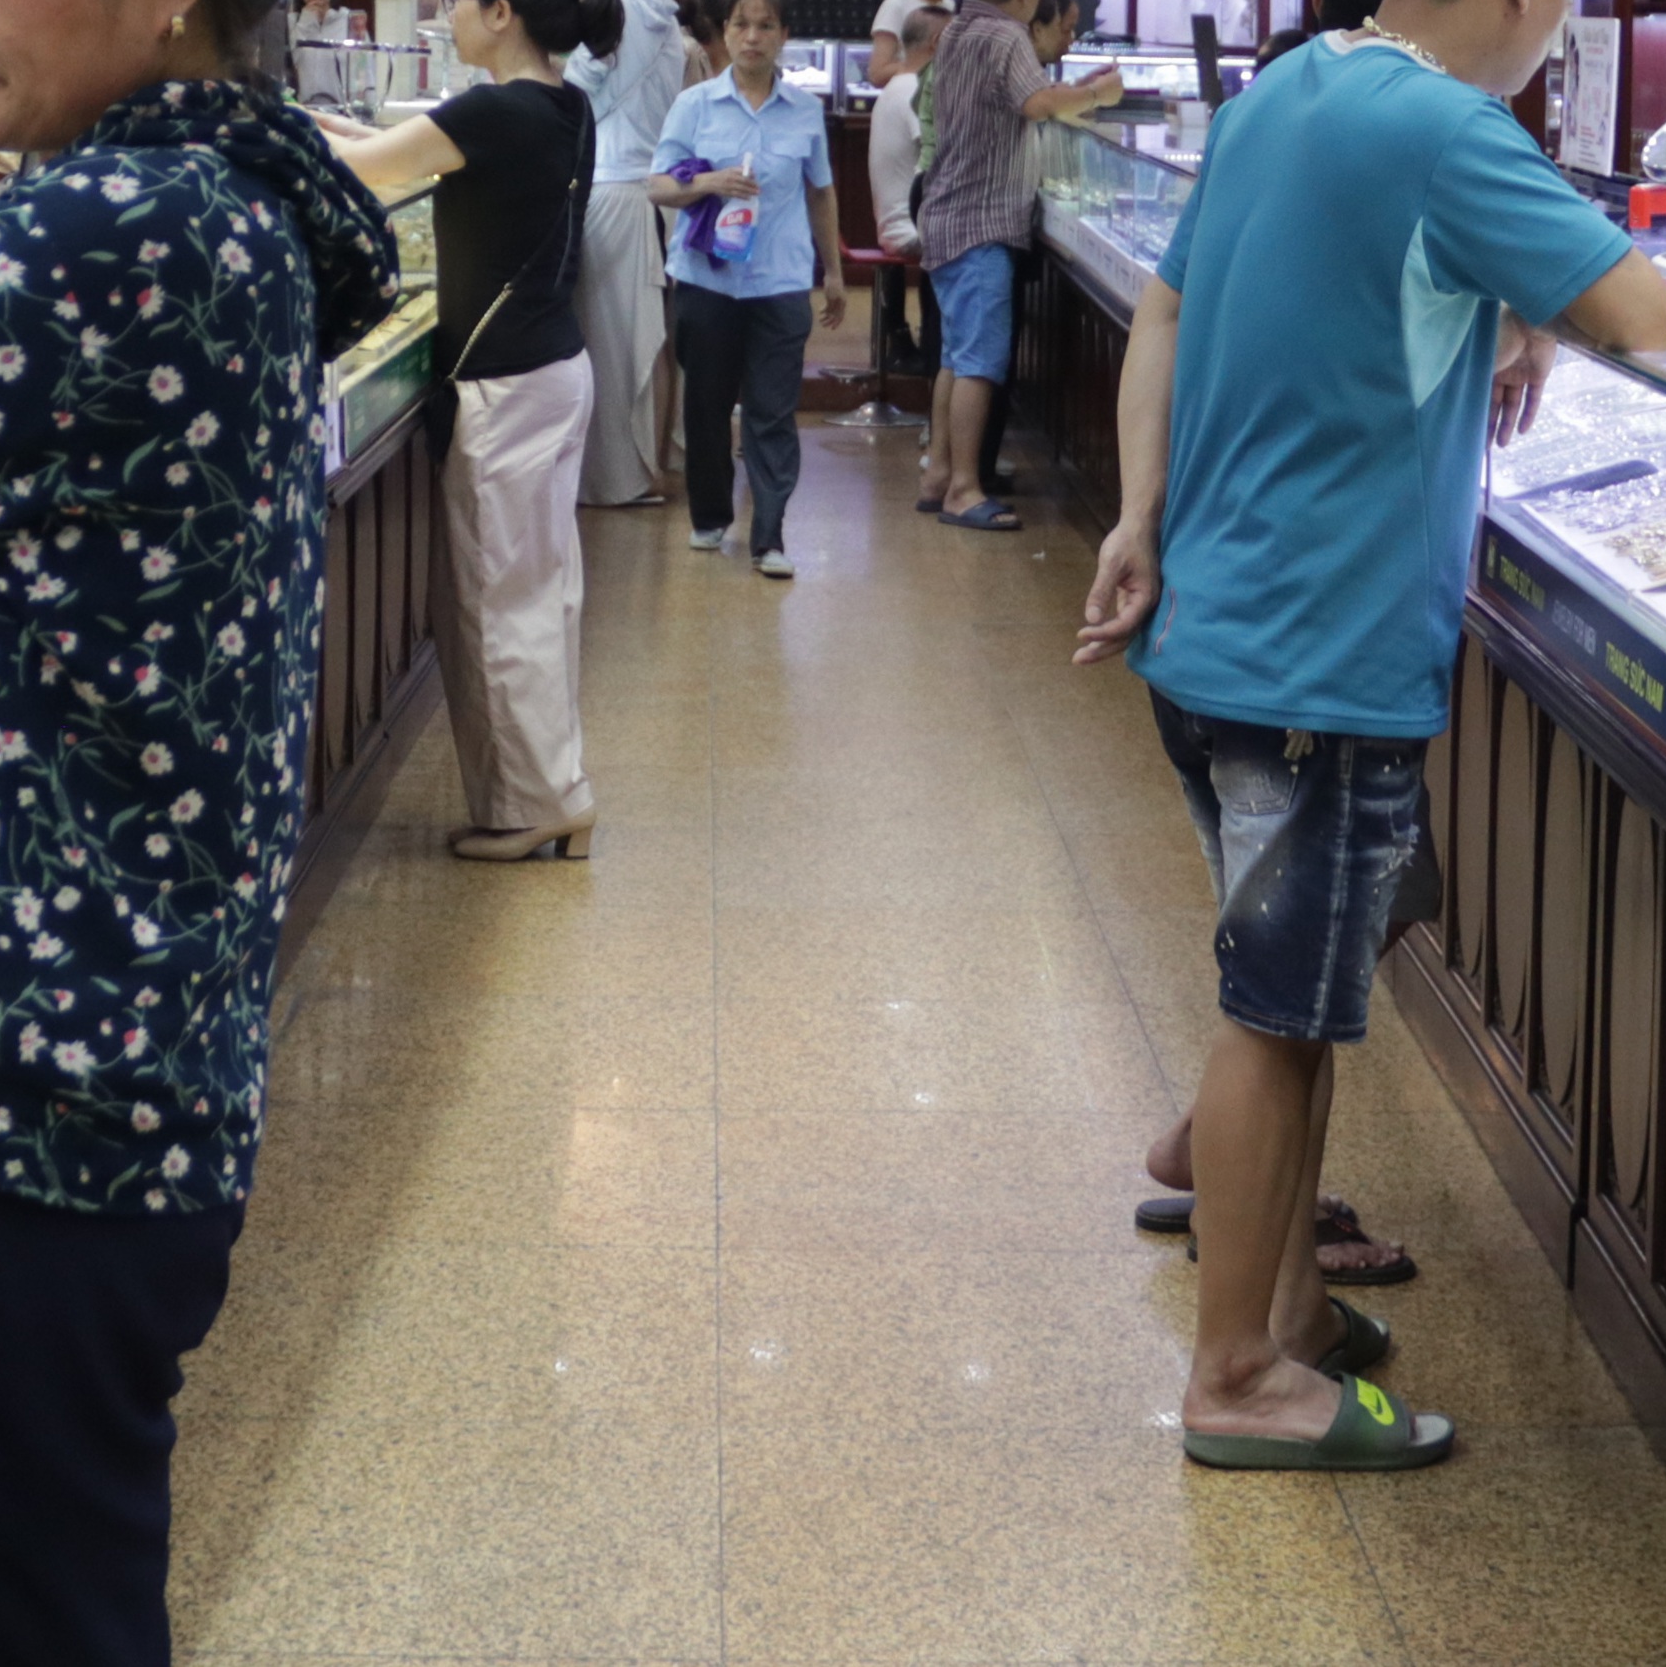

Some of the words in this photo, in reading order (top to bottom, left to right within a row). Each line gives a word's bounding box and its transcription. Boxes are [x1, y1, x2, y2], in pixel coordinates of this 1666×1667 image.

[1605, 641, 1630, 685] TRANG
[1630, 658, 1647, 698] SỨC
[1646, 677, 1665, 713] NAM
